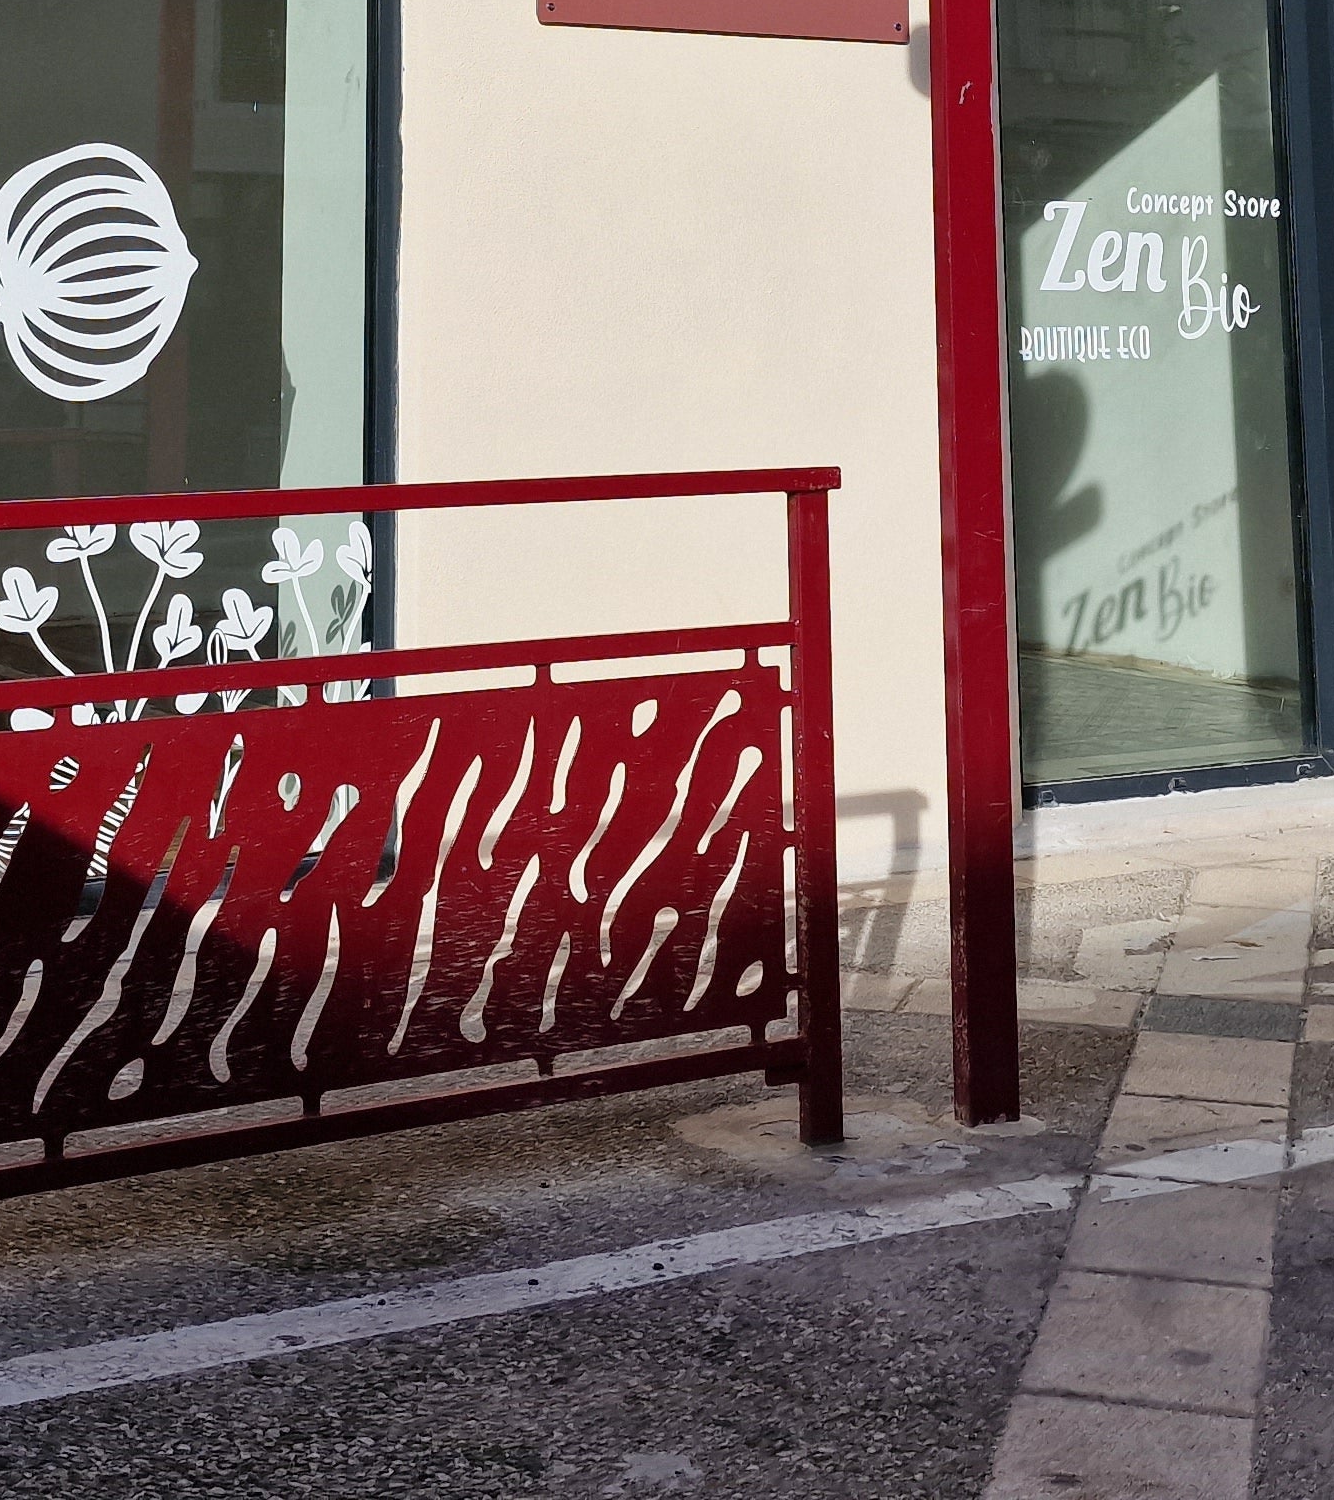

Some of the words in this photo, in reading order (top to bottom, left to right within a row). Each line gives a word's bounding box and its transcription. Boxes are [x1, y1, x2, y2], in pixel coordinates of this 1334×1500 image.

[1126, 186, 1214, 222] Concept
[1223, 189, 1281, 218] Store
[1039, 200, 1167, 293] Zen
[1177, 235, 1261, 340] Bio
[1019, 325, 1112, 363] BOUTIQUE
[1116, 325, 1151, 360] ECO
